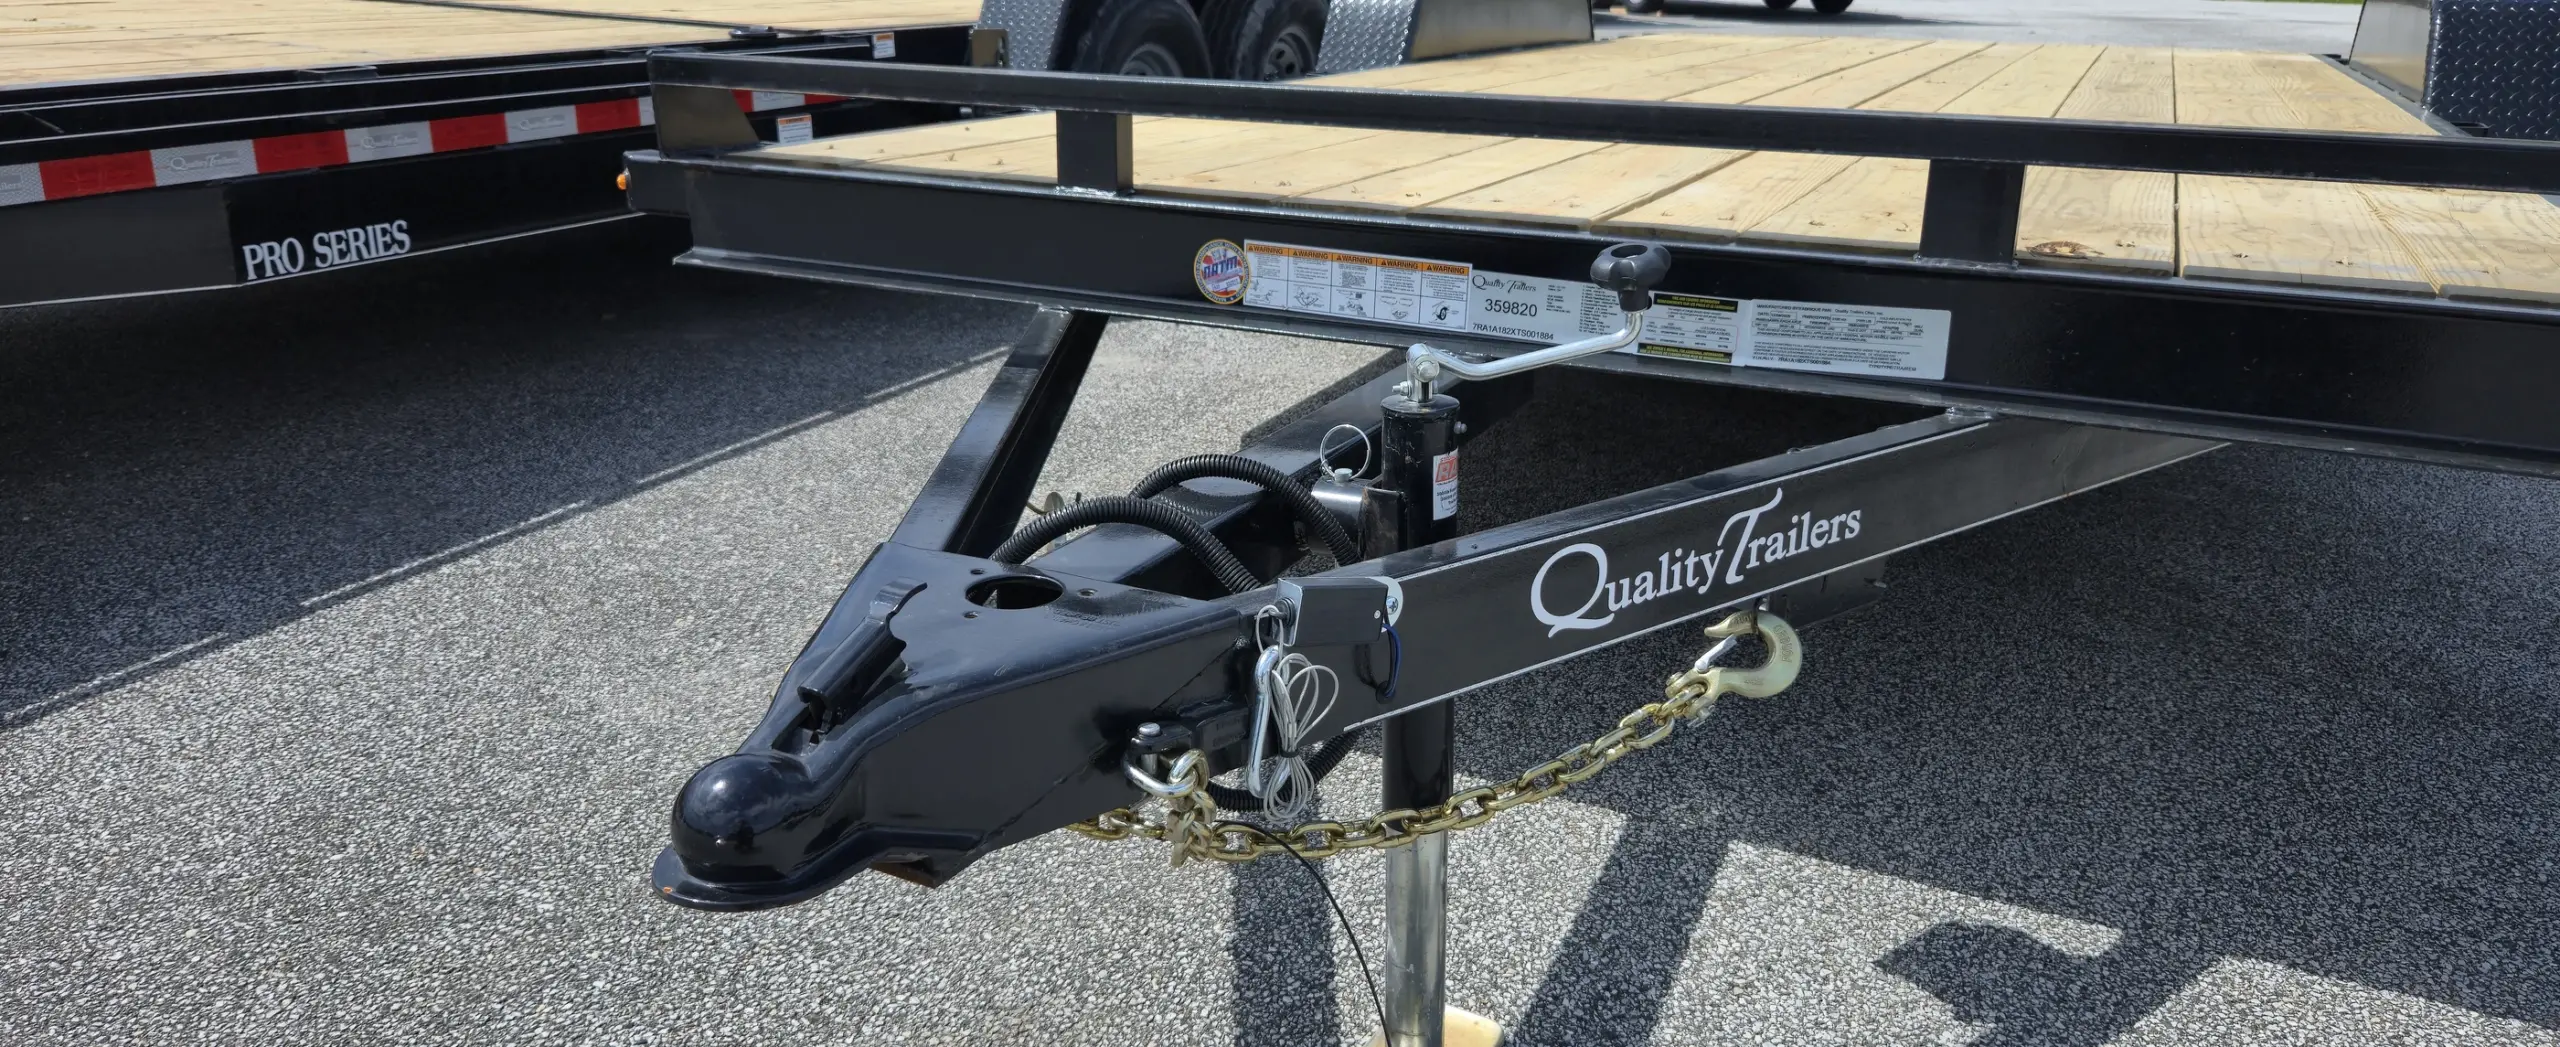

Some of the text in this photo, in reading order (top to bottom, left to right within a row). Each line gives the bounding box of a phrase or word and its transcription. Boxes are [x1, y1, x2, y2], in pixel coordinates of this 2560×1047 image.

[242, 219, 411, 280] PRO SERIES
[1253, 245, 1284, 255] WARNING
[1299, 250, 1329, 260] WARNING
[1341, 254, 1373, 265] WARNING
[1386, 260, 1418, 270] WARNING
[1432, 265, 1465, 275] WARNING
[1472, 274, 1506, 291] Quality
[1506, 279, 1537, 294] Trailers
[1484, 298, 1538, 318] 359820
[1530, 487, 1862, 638] Quality Trailers
